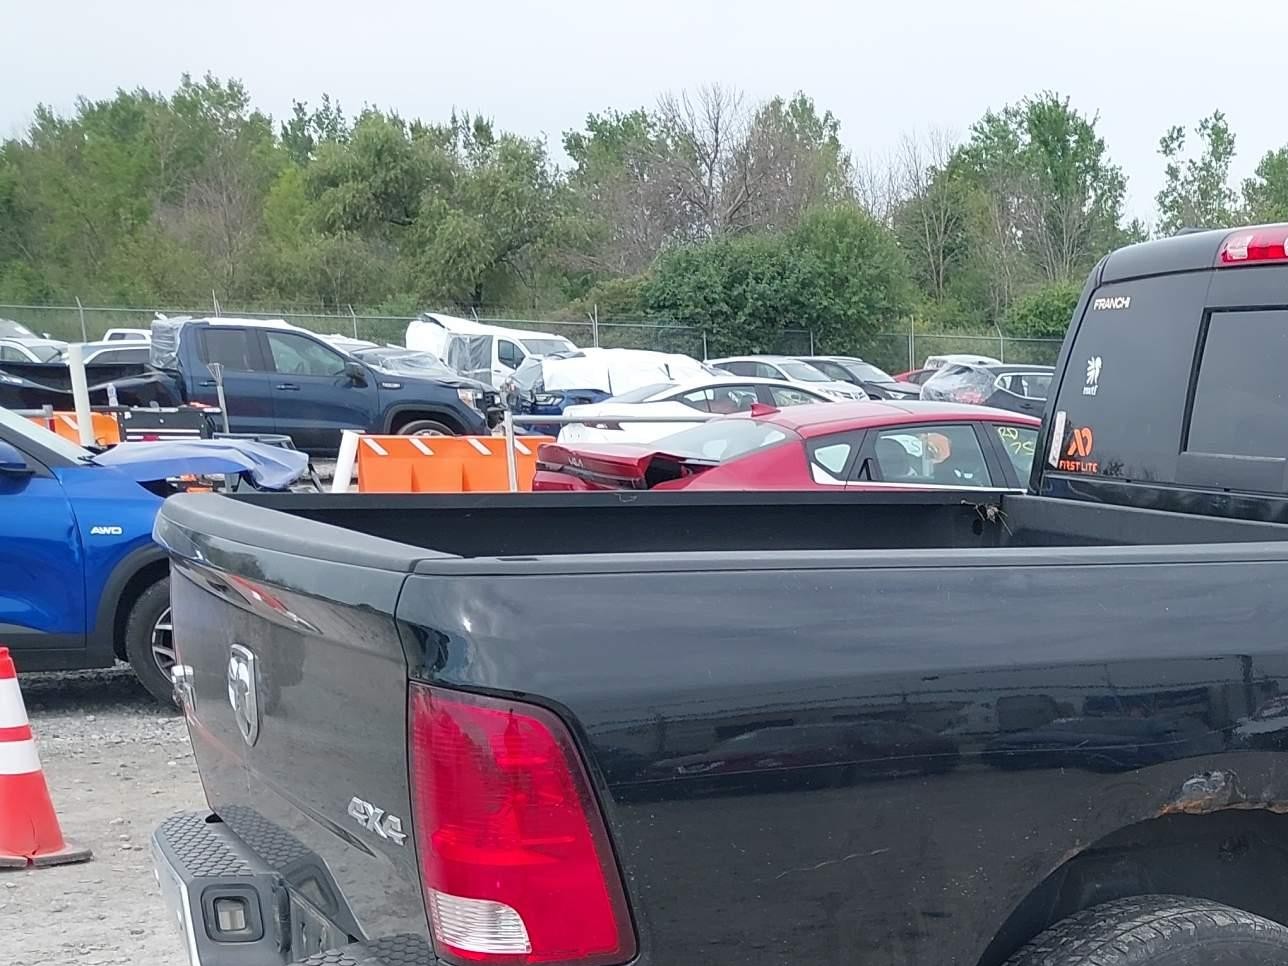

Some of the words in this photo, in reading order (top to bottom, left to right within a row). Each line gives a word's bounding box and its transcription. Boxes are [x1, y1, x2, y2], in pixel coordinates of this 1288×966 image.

[1093, 297, 1131, 311] FRANCHI
[1059, 460, 1081, 471] FIRST
[1081, 461, 1098, 473] LITE
[90, 526, 123, 535] AWD
